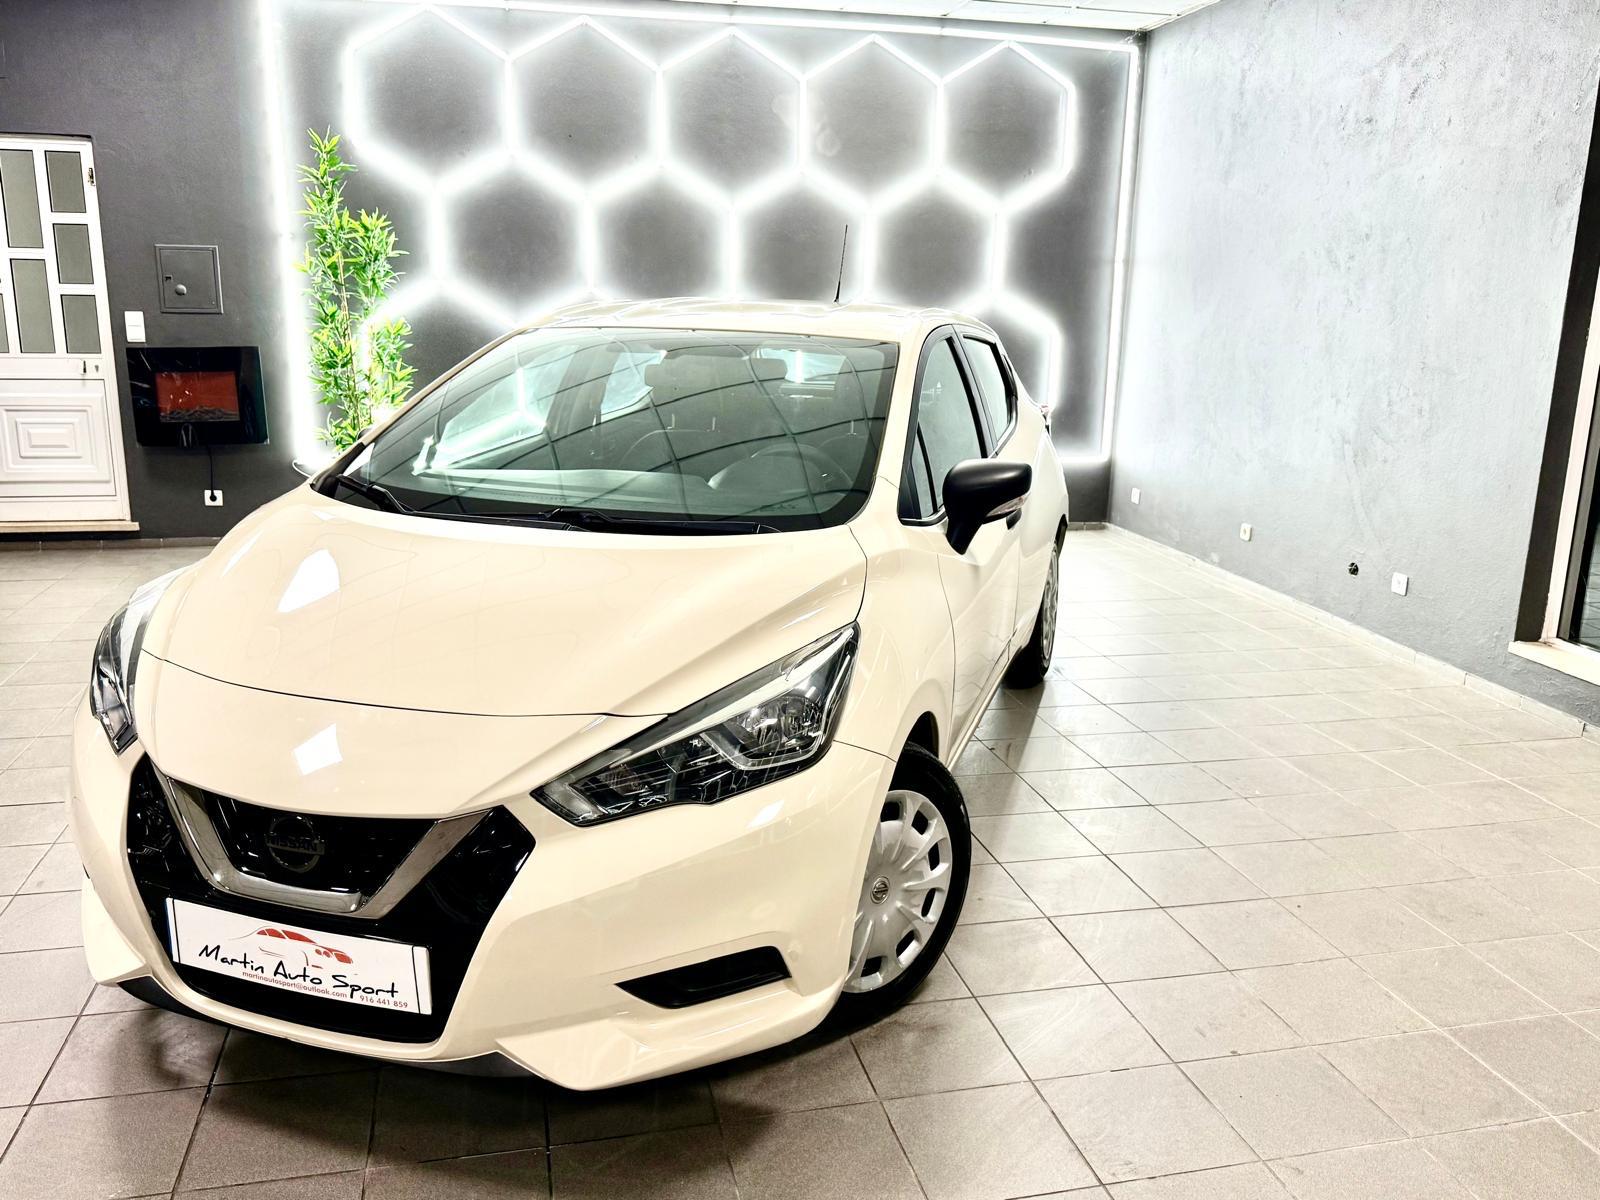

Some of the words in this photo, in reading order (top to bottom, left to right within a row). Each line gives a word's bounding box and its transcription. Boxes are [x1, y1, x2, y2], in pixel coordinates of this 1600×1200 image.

[198, 944, 265, 974] Martin
[273, 959, 323, 985] Auto
[331, 974, 399, 999] Sport
[242, 971, 348, 998] martinautosport@outlook.com
[359, 995, 375, 1004] 916
[376, 998, 391, 1006] 441
[393, 1000, 408, 1009] 859
